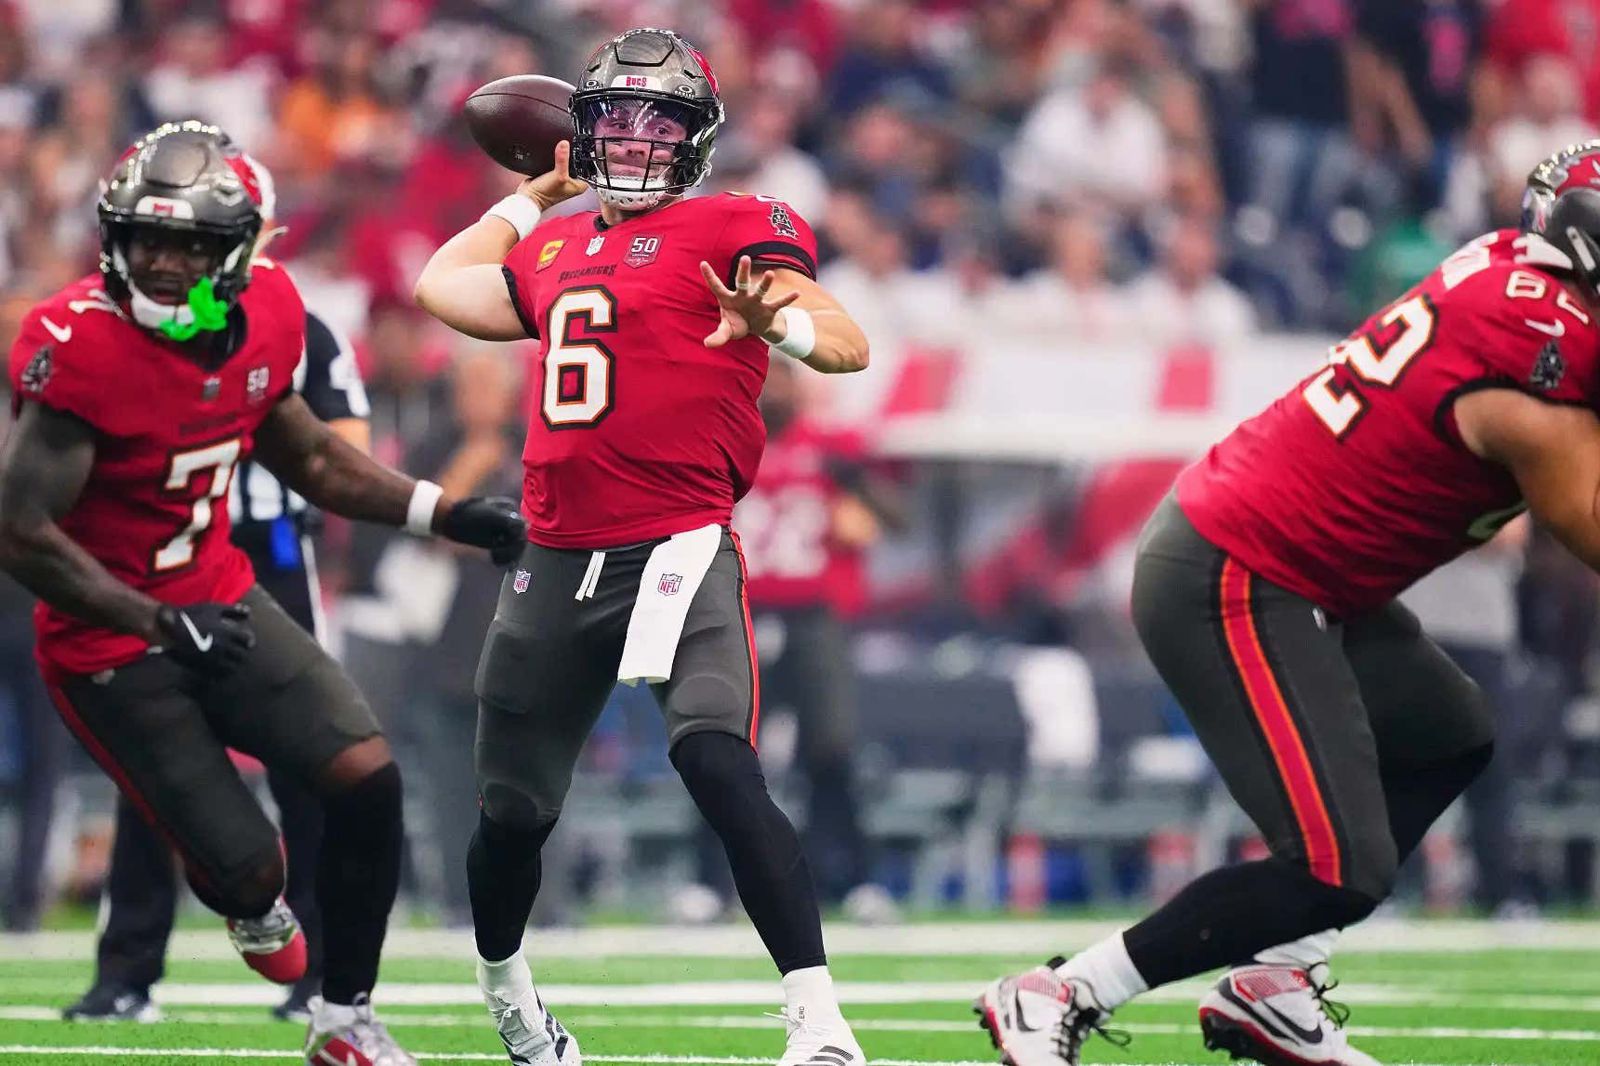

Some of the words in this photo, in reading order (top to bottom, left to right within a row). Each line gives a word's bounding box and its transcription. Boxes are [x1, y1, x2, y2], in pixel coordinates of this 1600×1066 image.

[625, 76, 647, 87] BUCS
[540, 239, 564, 262] C
[631, 237, 658, 253] 50
[541, 284, 618, 431] 6
[155, 437, 242, 572] 7
[515, 580, 528, 590] NFL
[659, 580, 677, 593] NFL
